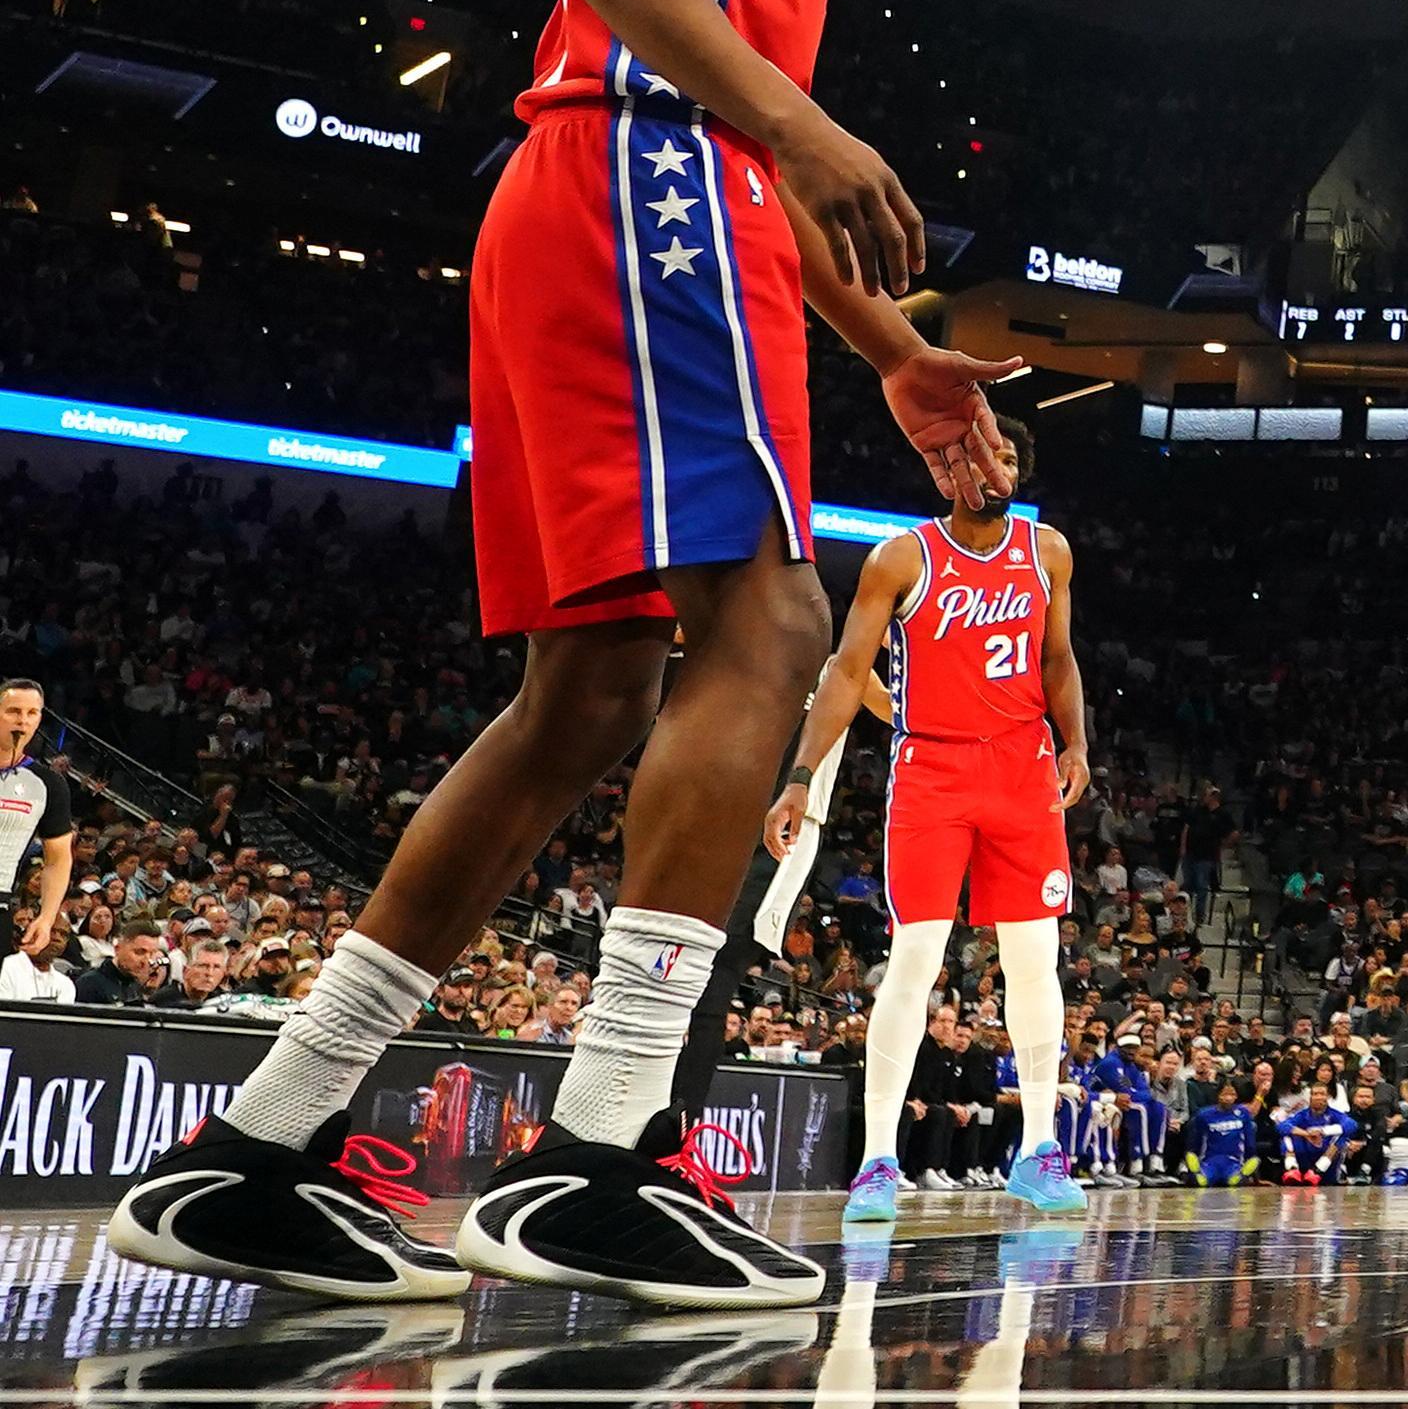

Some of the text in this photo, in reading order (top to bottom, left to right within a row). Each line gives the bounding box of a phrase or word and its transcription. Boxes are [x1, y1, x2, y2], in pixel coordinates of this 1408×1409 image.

[320, 115, 421, 154] Ownwell
[1053, 252, 1123, 283] beldon
[1288, 307, 1318, 321] REB
[1334, 309, 1366, 321] AST
[60, 408, 387, 471] ticketmaster ticketmaster
[935, 584, 1031, 641] Phila
[984, 632, 1030, 679] 21
